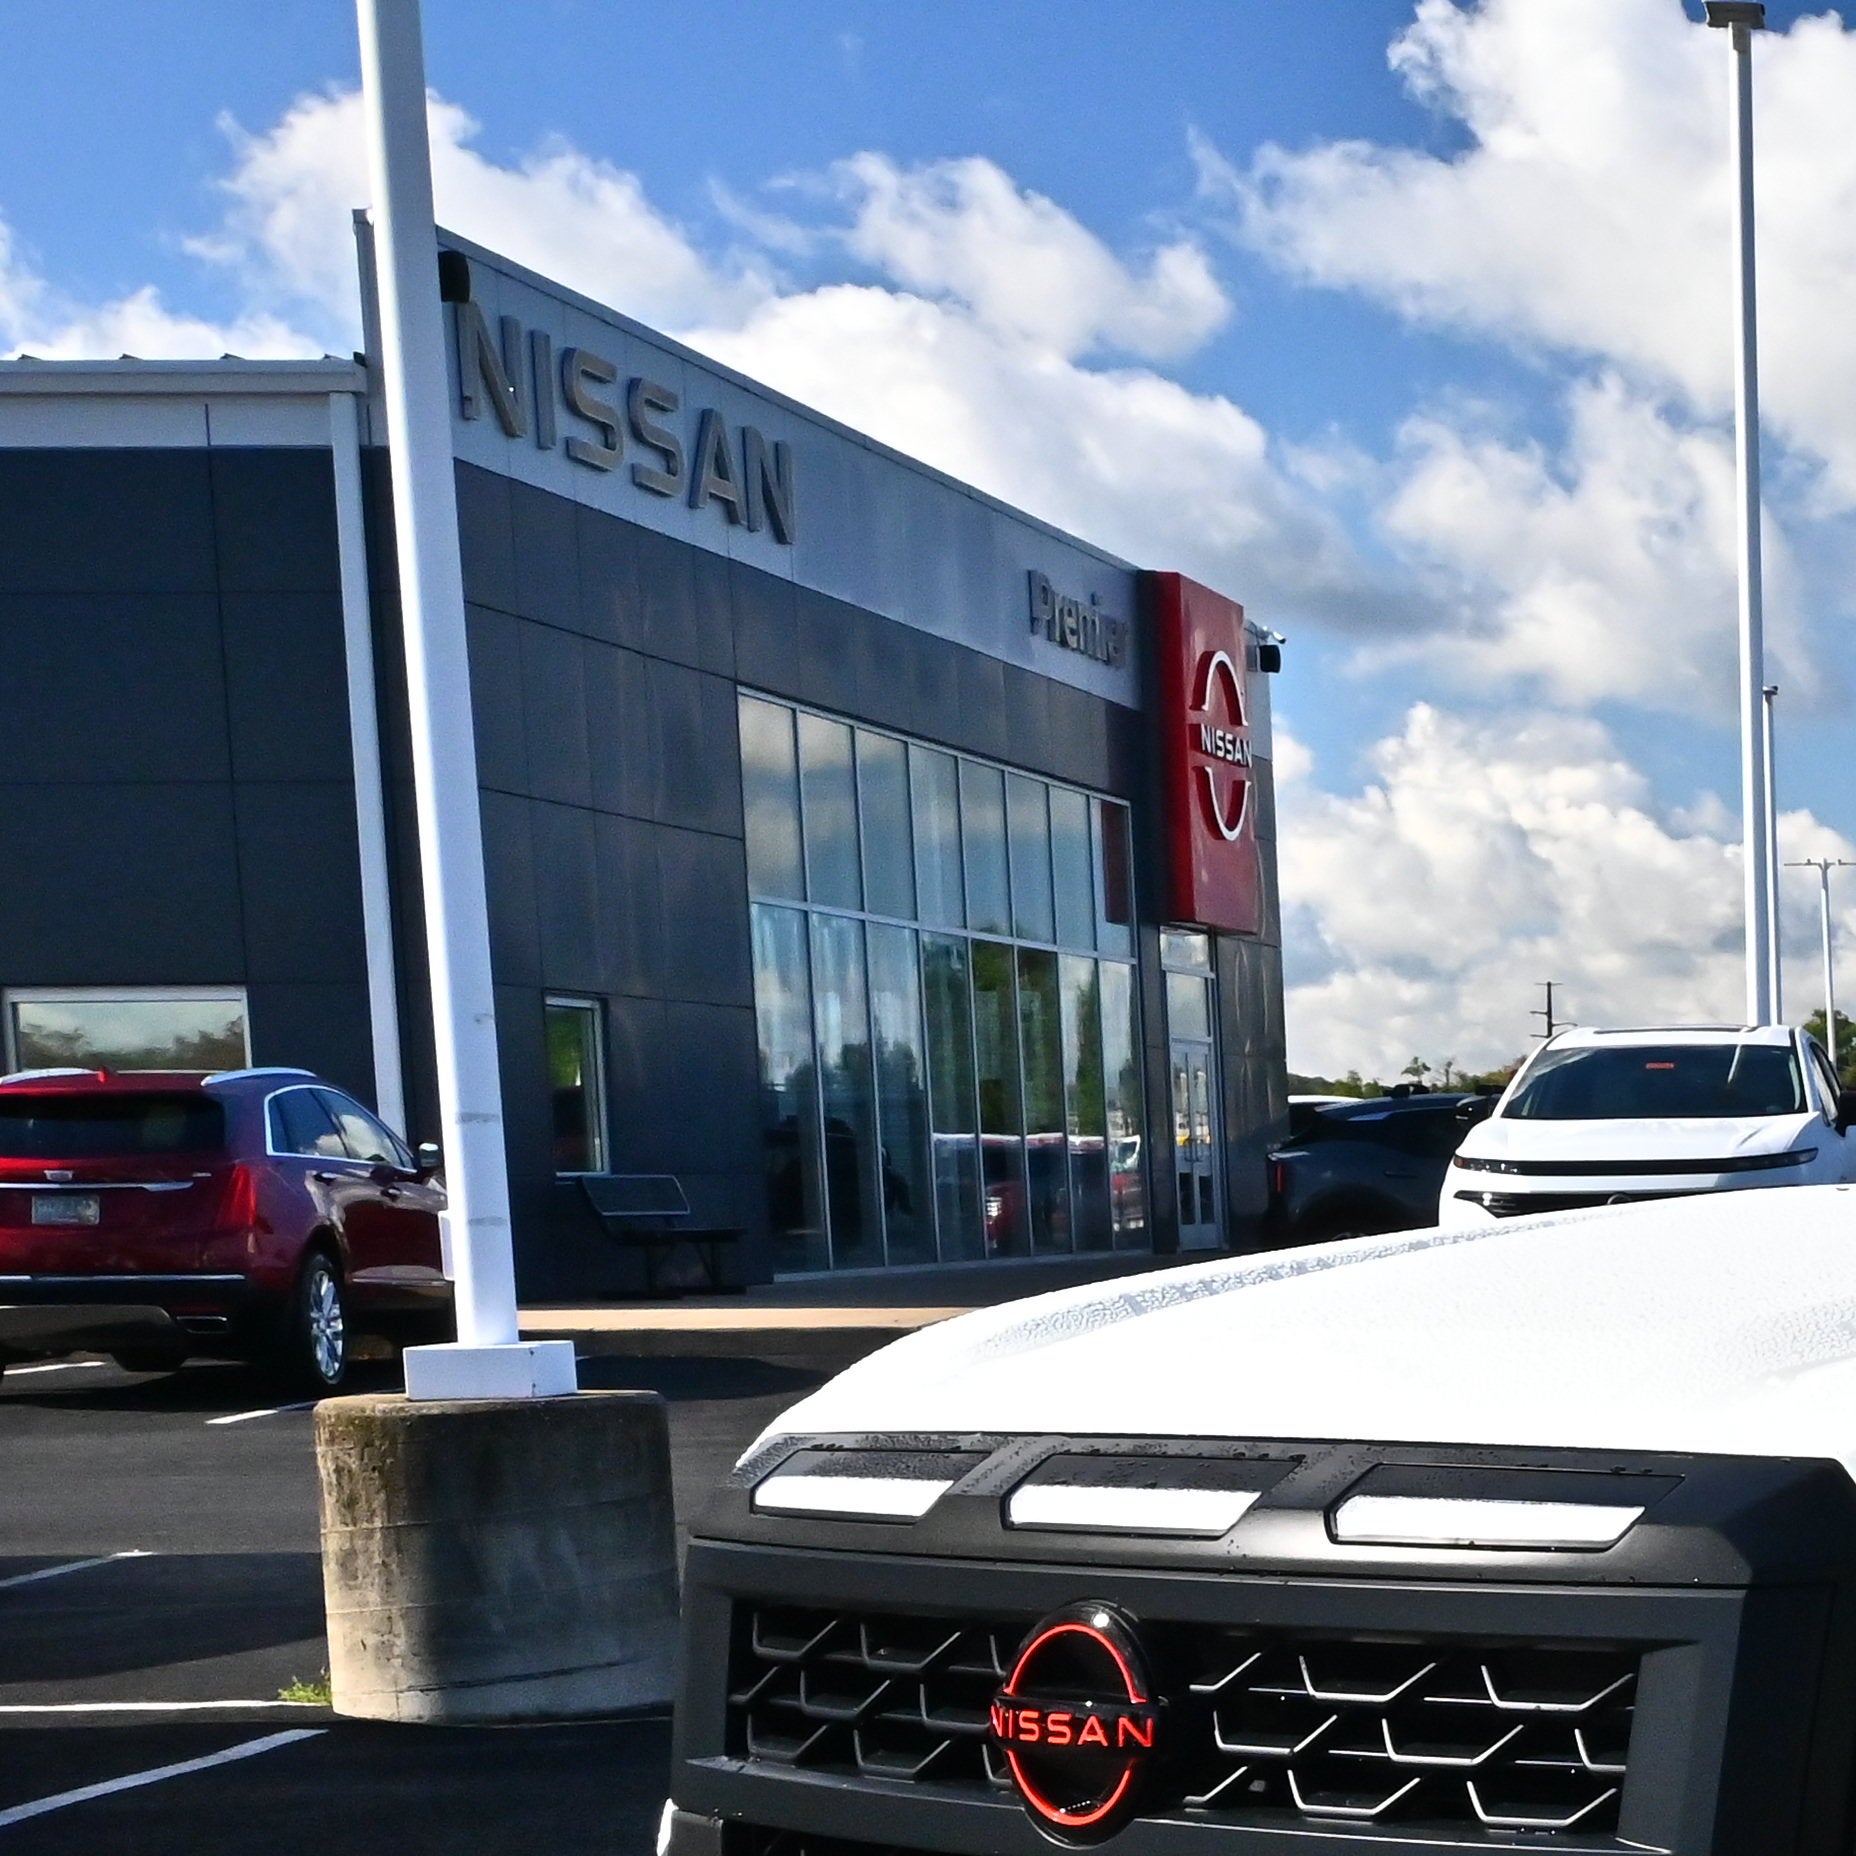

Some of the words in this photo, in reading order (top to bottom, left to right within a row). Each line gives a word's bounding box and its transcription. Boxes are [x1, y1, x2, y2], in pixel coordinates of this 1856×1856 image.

[455, 301, 796, 545] NISSAN
[1027, 569, 1128, 669] Premier
[1201, 723, 1253, 769] NISSAN
[990, 1704, 1154, 1748] NISSAN
